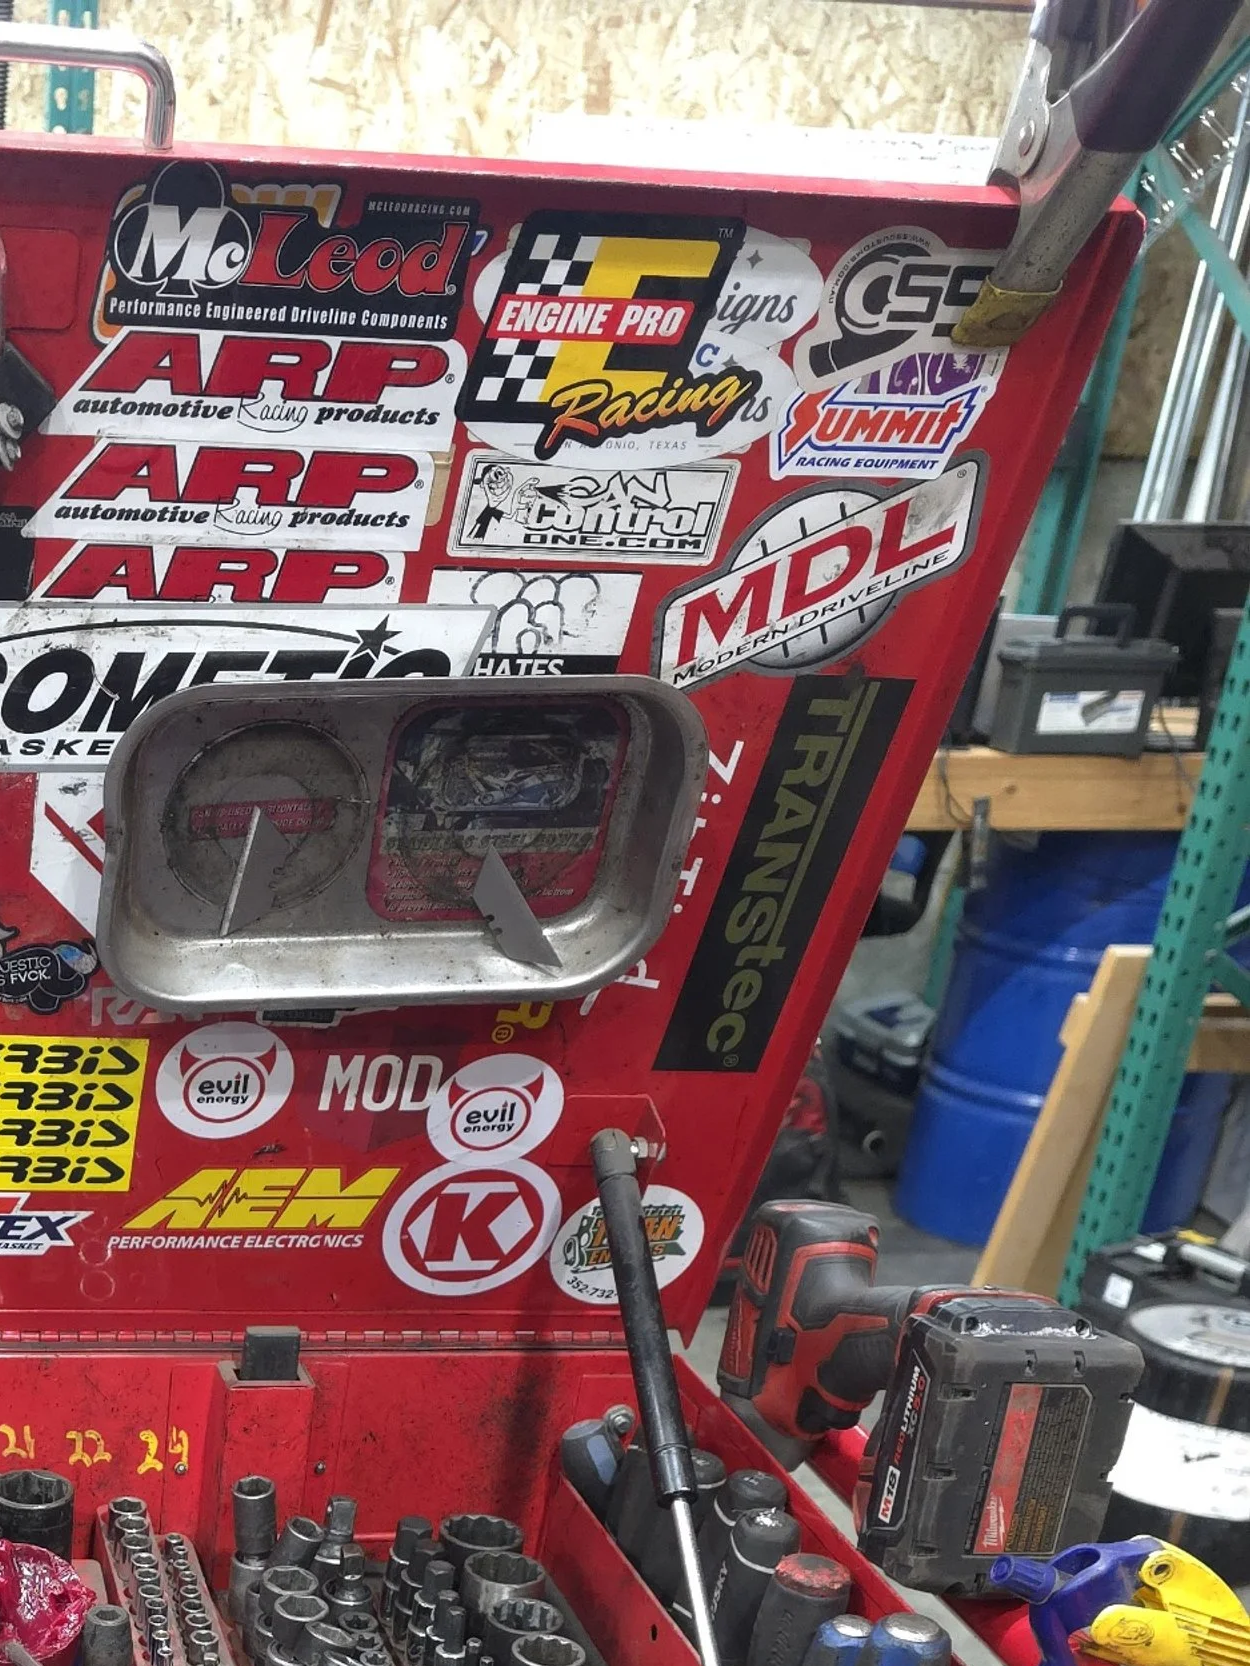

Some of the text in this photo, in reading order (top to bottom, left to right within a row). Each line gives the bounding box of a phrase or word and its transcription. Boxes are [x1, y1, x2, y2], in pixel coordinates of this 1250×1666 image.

[367, 200, 471, 216] MCLEODRACING.COM
[109, 297, 449, 330] Performance Engineered Driveline Components
[496, 302, 687, 337] ENGINE PRO
[79, 329, 450, 404] ARP
[72, 398, 233, 420] automotive
[317, 407, 441, 426] products
[545, 372, 752, 448] Racing
[649, 440, 688, 451] TEXAS
[61, 442, 419, 508] ARP
[796, 456, 940, 471] RACING EQUIPMENT
[53, 504, 209, 525] automotive
[288, 509, 411, 529] products
[523, 532, 701, 550] ONE.COM
[41, 545, 389, 603] ARP
[678, 498, 958, 666] MDL
[672, 549, 950, 686] MODERN DRIVELINE
[706, 697, 859, 1054] TRANStec
[196, 1094, 250, 1106] energy
[198, 1072, 251, 1096] evil
[463, 1121, 515, 1135] energy
[465, 1099, 516, 1125] evil
[123, 1167, 402, 1230] AEM
[107, 1233, 365, 1251] PERFORMANCE ELECTRONICS
[65, 1429, 112, 1467] 22
[137, 1425, 189, 1476] 24
[880, 1468, 901, 1519] M18
